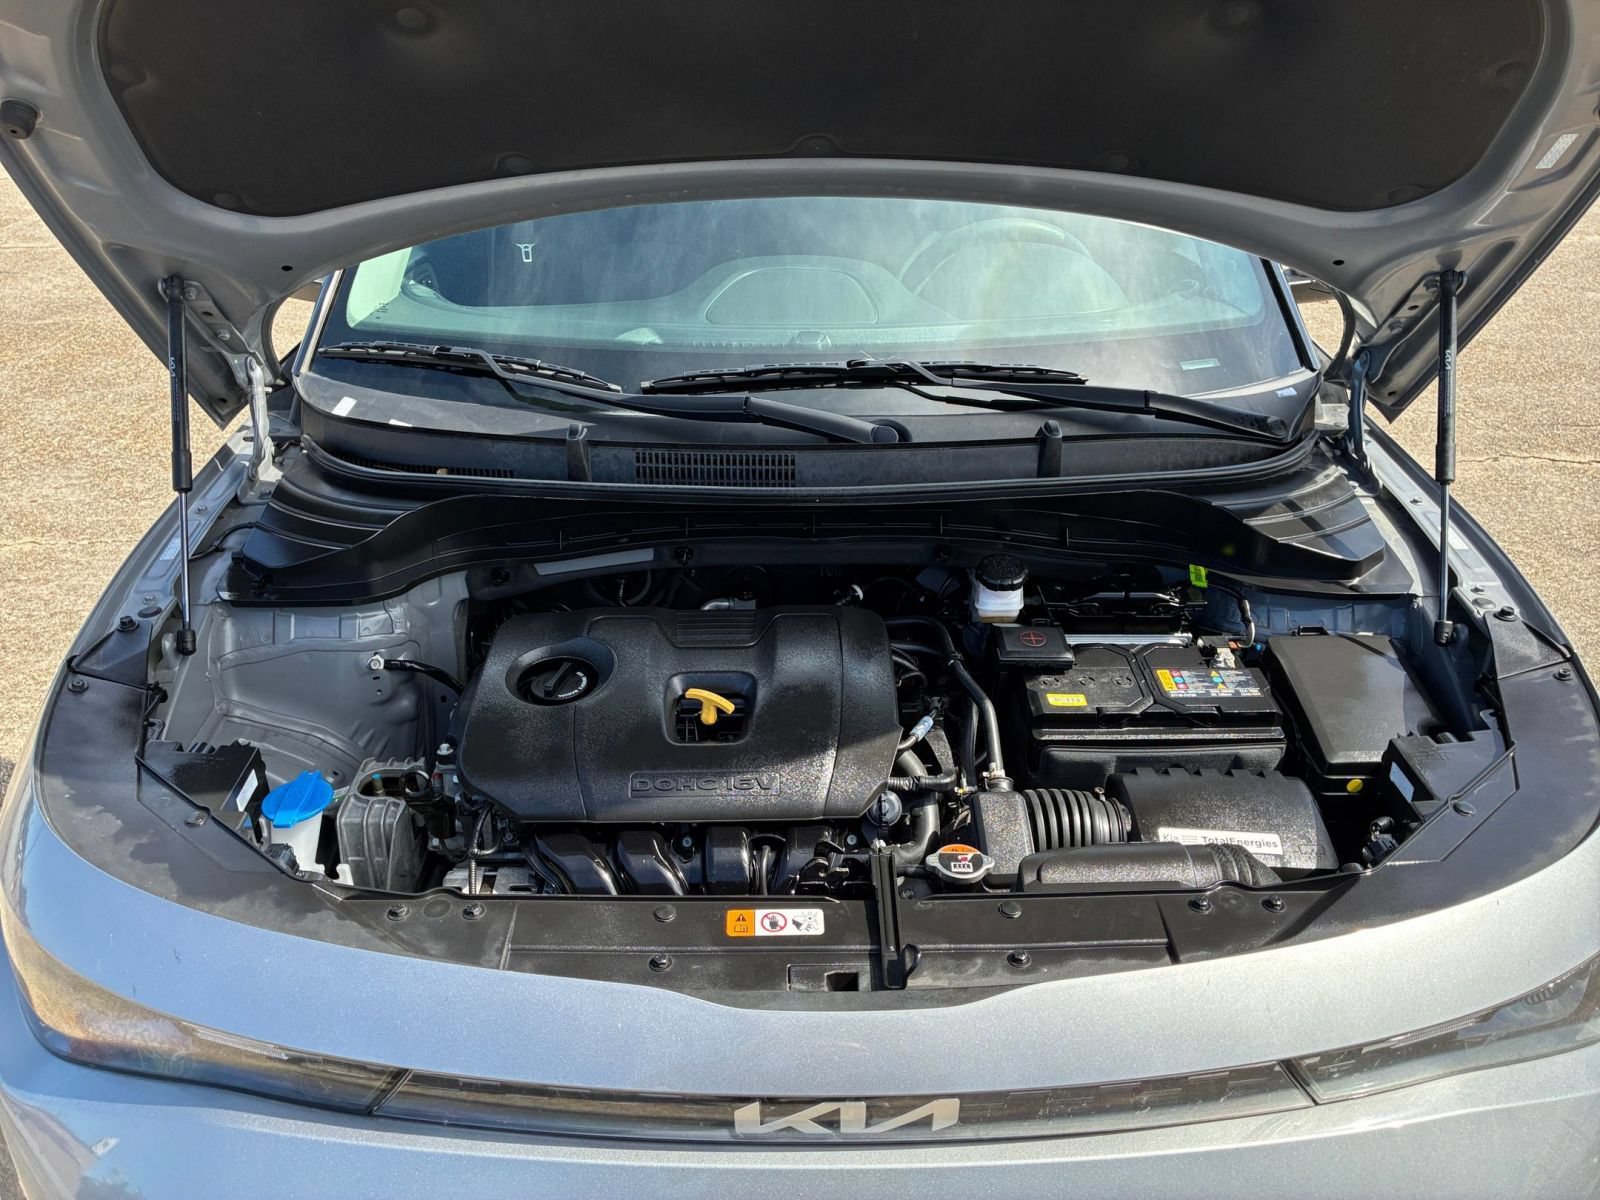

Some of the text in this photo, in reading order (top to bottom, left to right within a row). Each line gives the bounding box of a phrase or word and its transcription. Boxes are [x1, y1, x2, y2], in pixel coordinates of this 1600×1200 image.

[632, 775, 778, 791] DOHC 16V
[1201, 835, 1278, 848] TotalEnergies
[734, 1098, 960, 1134] KIA
